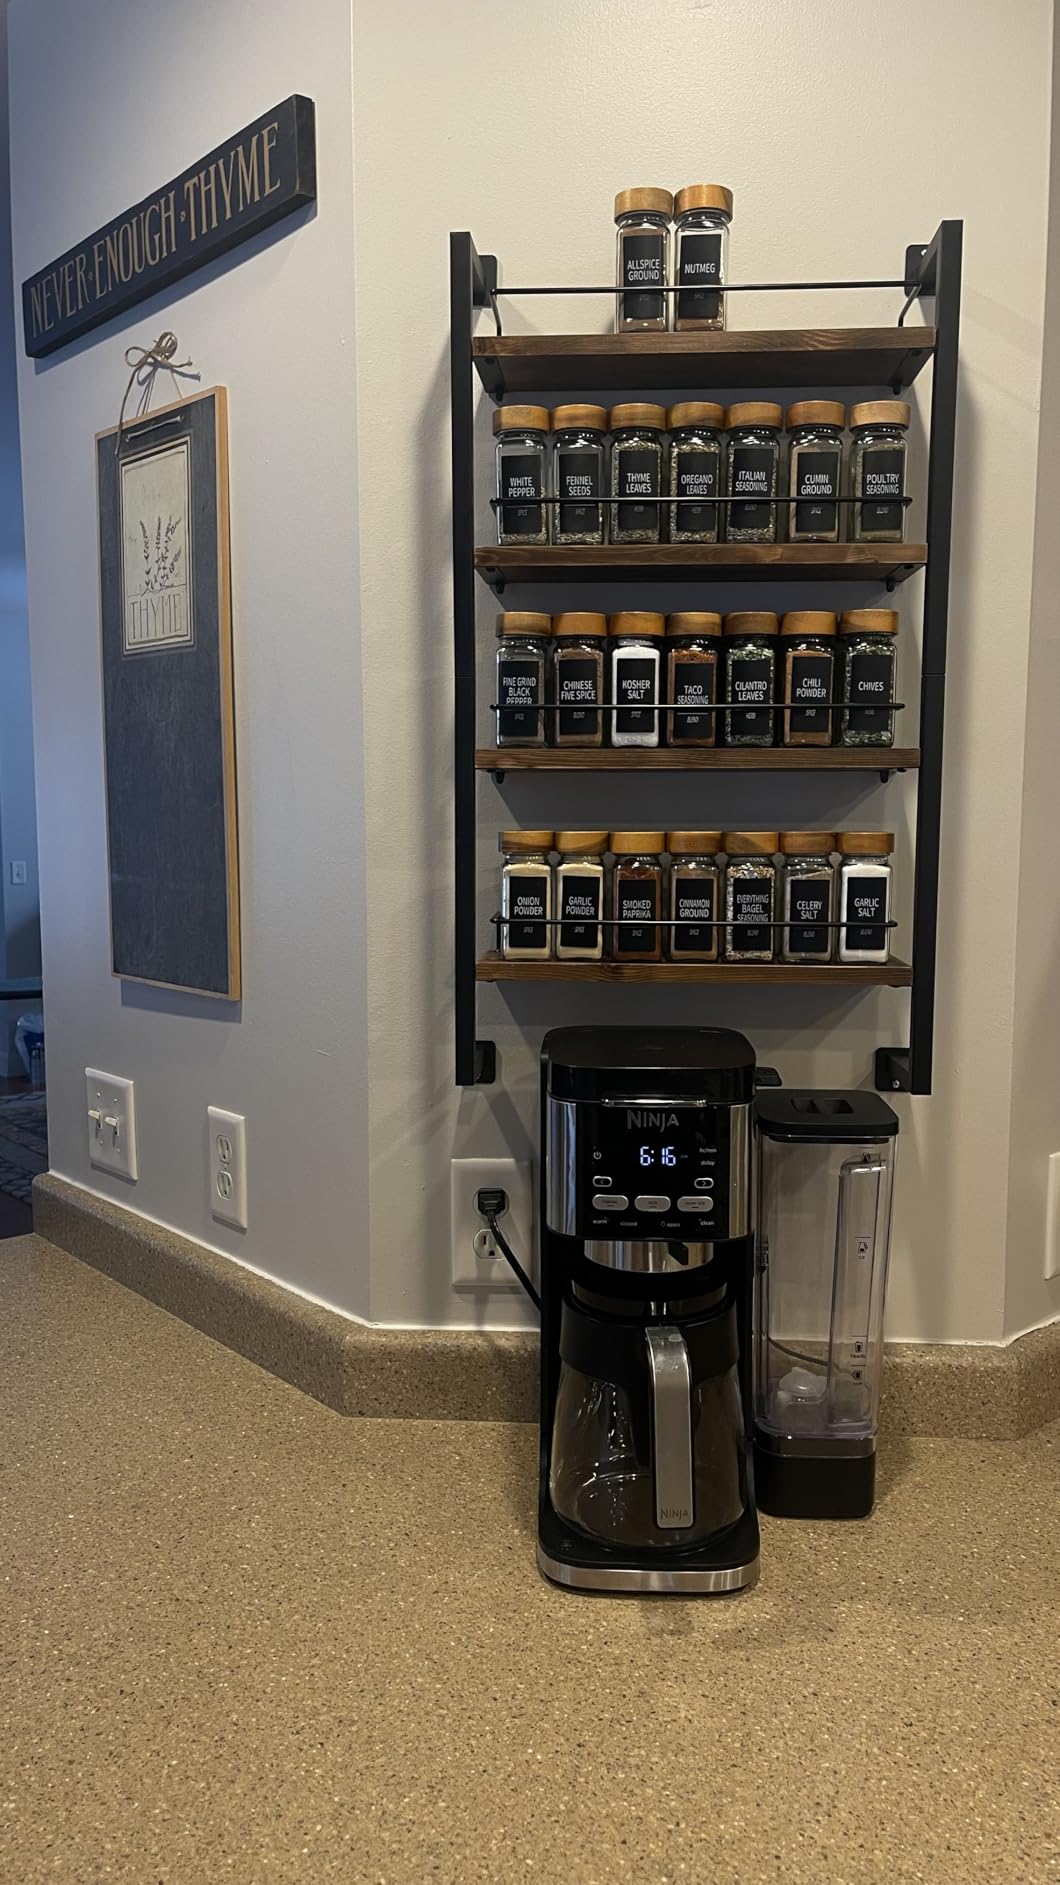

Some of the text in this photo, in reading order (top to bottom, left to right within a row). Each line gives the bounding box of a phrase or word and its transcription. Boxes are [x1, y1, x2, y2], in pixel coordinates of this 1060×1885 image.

[30, 121, 281, 338] NEVER ENOUGH THYME
[627, 258, 660, 270] ALLSPICE
[684, 263, 715, 274] NUTMEG
[628, 270, 660, 281] GROUND
[510, 476, 533, 487] WHITE
[565, 475, 593, 486] FENNEL
[626, 472, 651, 483] THYME
[681, 474, 713, 485] OREGANO
[738, 470, 766, 482] ITALIAN
[804, 474, 829, 484] CUMIN
[866, 473, 899, 484] POULTRY
[508, 487, 535, 497] PEPPER
[568, 486, 591, 496] SEEDS
[626, 483, 652, 494] LEAVES
[686, 485, 707, 495] LEAVES
[735, 481, 767, 492] SEASONING
[801, 484, 832, 495] GROUND
[866, 484, 899, 495] SEASONING
[503, 676, 536, 687] FINE GRIND
[563, 680, 592, 691] CHINESE
[622, 679, 650, 689] KOSHER
[735, 680, 767, 691] CILANTRO
[802, 677, 821, 688] CHILI
[858, 681, 884, 692] CHIVES
[508, 687, 531, 697] BLACK
[560, 690, 596, 700] FIVE SPICE
[627, 690, 644, 699] SALT
[683, 685, 703, 695] TACO
[796, 688, 826, 698] POWDER
[677, 695, 709, 705] SEASONING
[738, 691, 764, 701] LEAVES
[517, 896, 540, 906] ONION
[568, 896, 592, 906] GARLIC
[622, 899, 651, 909] SMOKED
[679, 899, 710, 908] CINNAMON
[736, 894, 769, 904] EVERYTHING
[854, 897, 879, 908] GARLIC
[513, 906, 543, 916] POWDER
[565, 905, 595, 916] POWDER
[741, 904, 764, 914] BAGEL
[796, 900, 823, 911] CELERY
[622, 909, 651, 919] PAPRIKA
[680, 908, 710, 918] GROUND
[737, 913, 768, 922] SEASONING
[800, 910, 818, 920] SALT
[857, 907, 875, 917] SALT
[627, 1109, 679, 1132] NINJA
[639, 1146, 676, 1167] 6:16
[660, 1508, 689, 1521] NINJA
